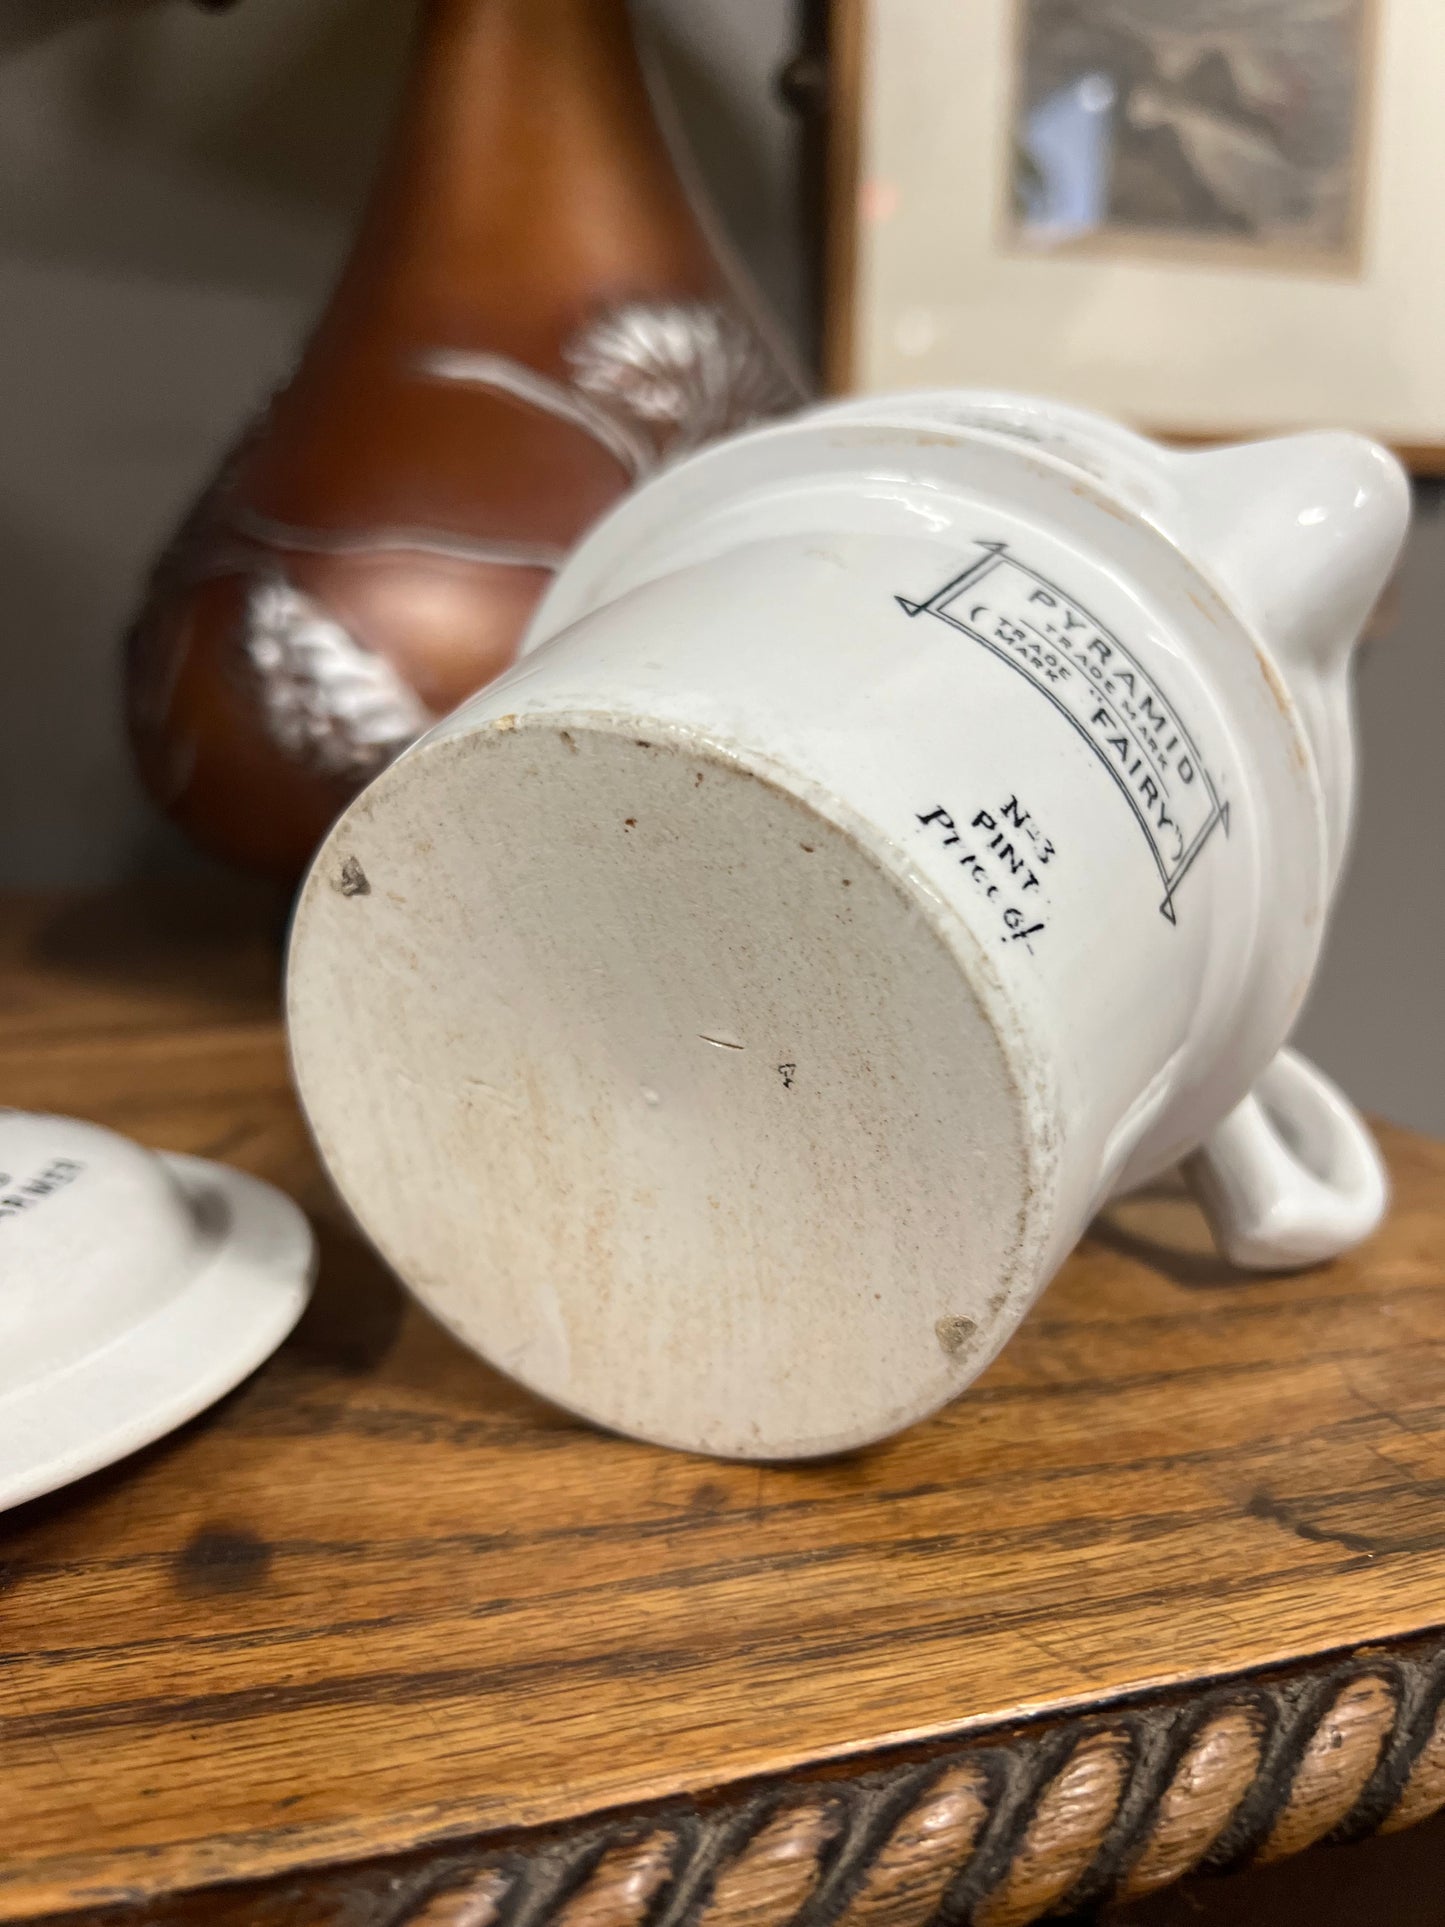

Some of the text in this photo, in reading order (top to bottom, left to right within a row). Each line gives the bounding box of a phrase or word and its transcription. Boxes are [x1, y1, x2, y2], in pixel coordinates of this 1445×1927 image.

[994, 628, 1060, 683] MARK
[1028, 589, 1195, 785] PYRAMID
[1045, 622, 1168, 771] TRADE MARK
[971, 810, 1040, 891] PINT
